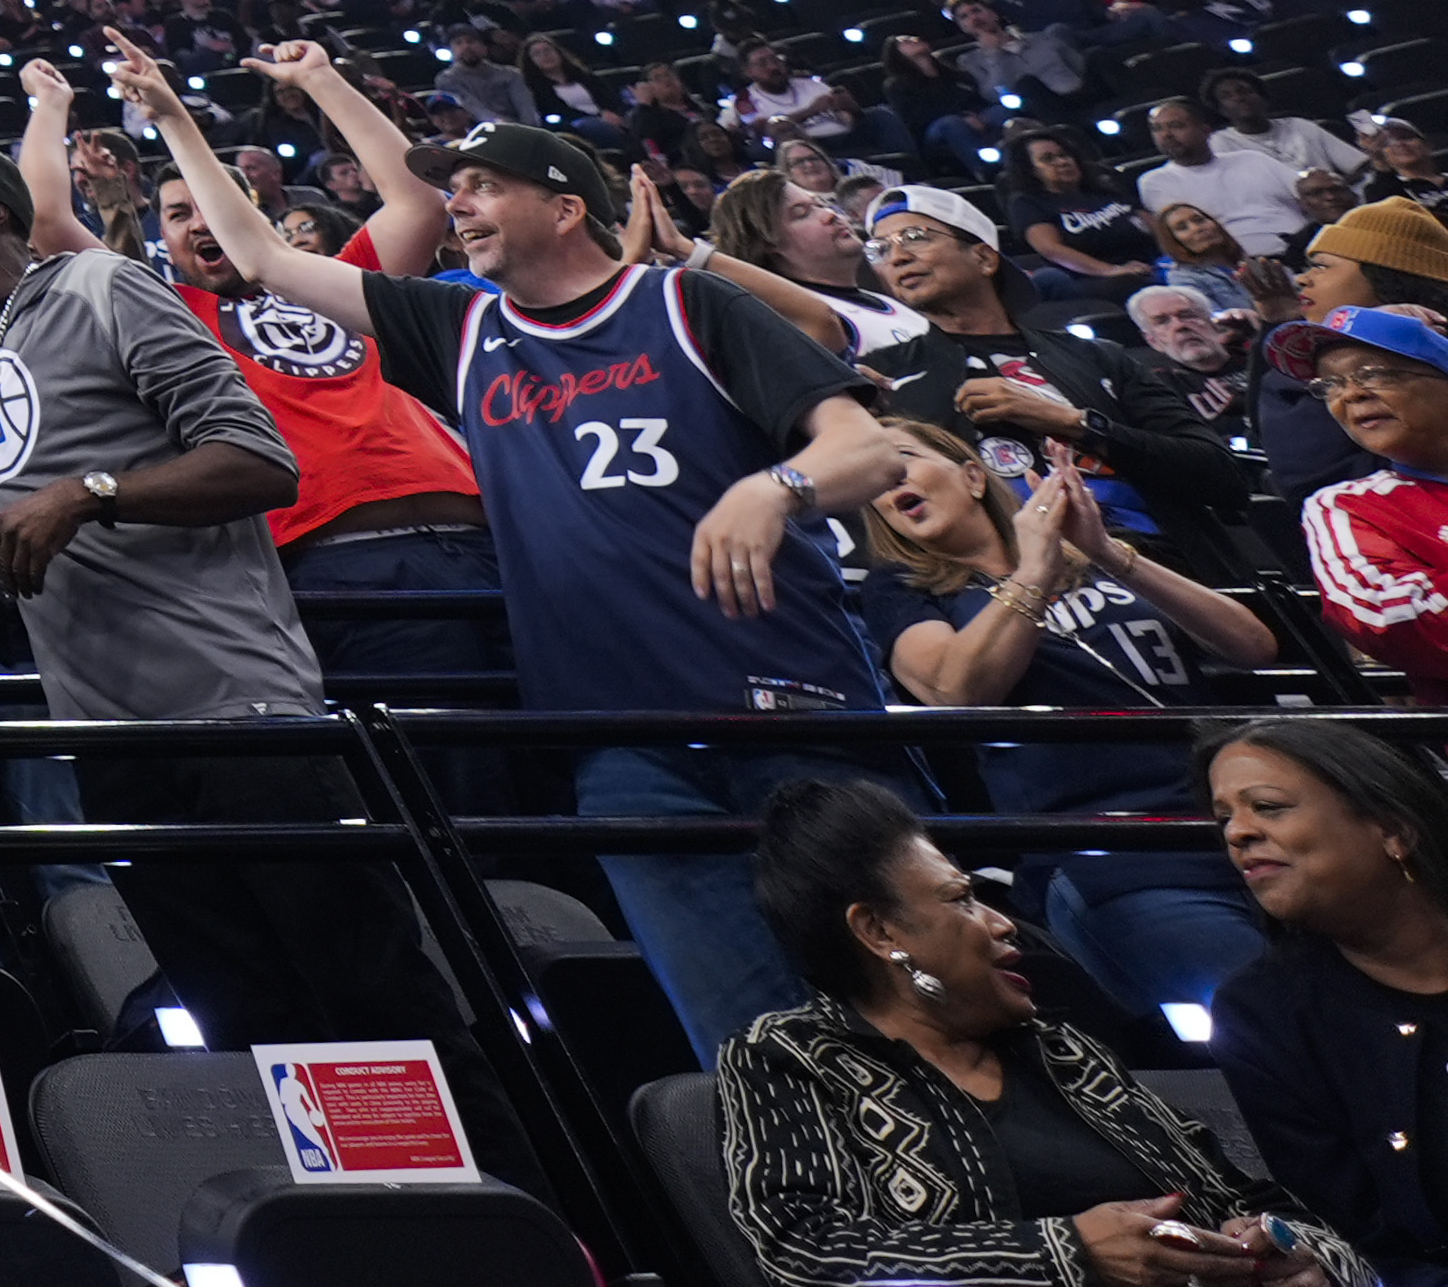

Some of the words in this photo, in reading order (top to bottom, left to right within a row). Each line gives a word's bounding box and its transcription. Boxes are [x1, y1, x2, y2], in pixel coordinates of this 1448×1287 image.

[253, 339, 364, 377] CLIPPERS
[481, 353, 661, 427] Clippers
[574, 417, 680, 491] 23
[1107, 619, 1190, 686] 13
[334, 1065, 370, 1076] CONDUCT
[371, 1065, 407, 1075] ADVISORY
[300, 1148, 326, 1168] NBA
